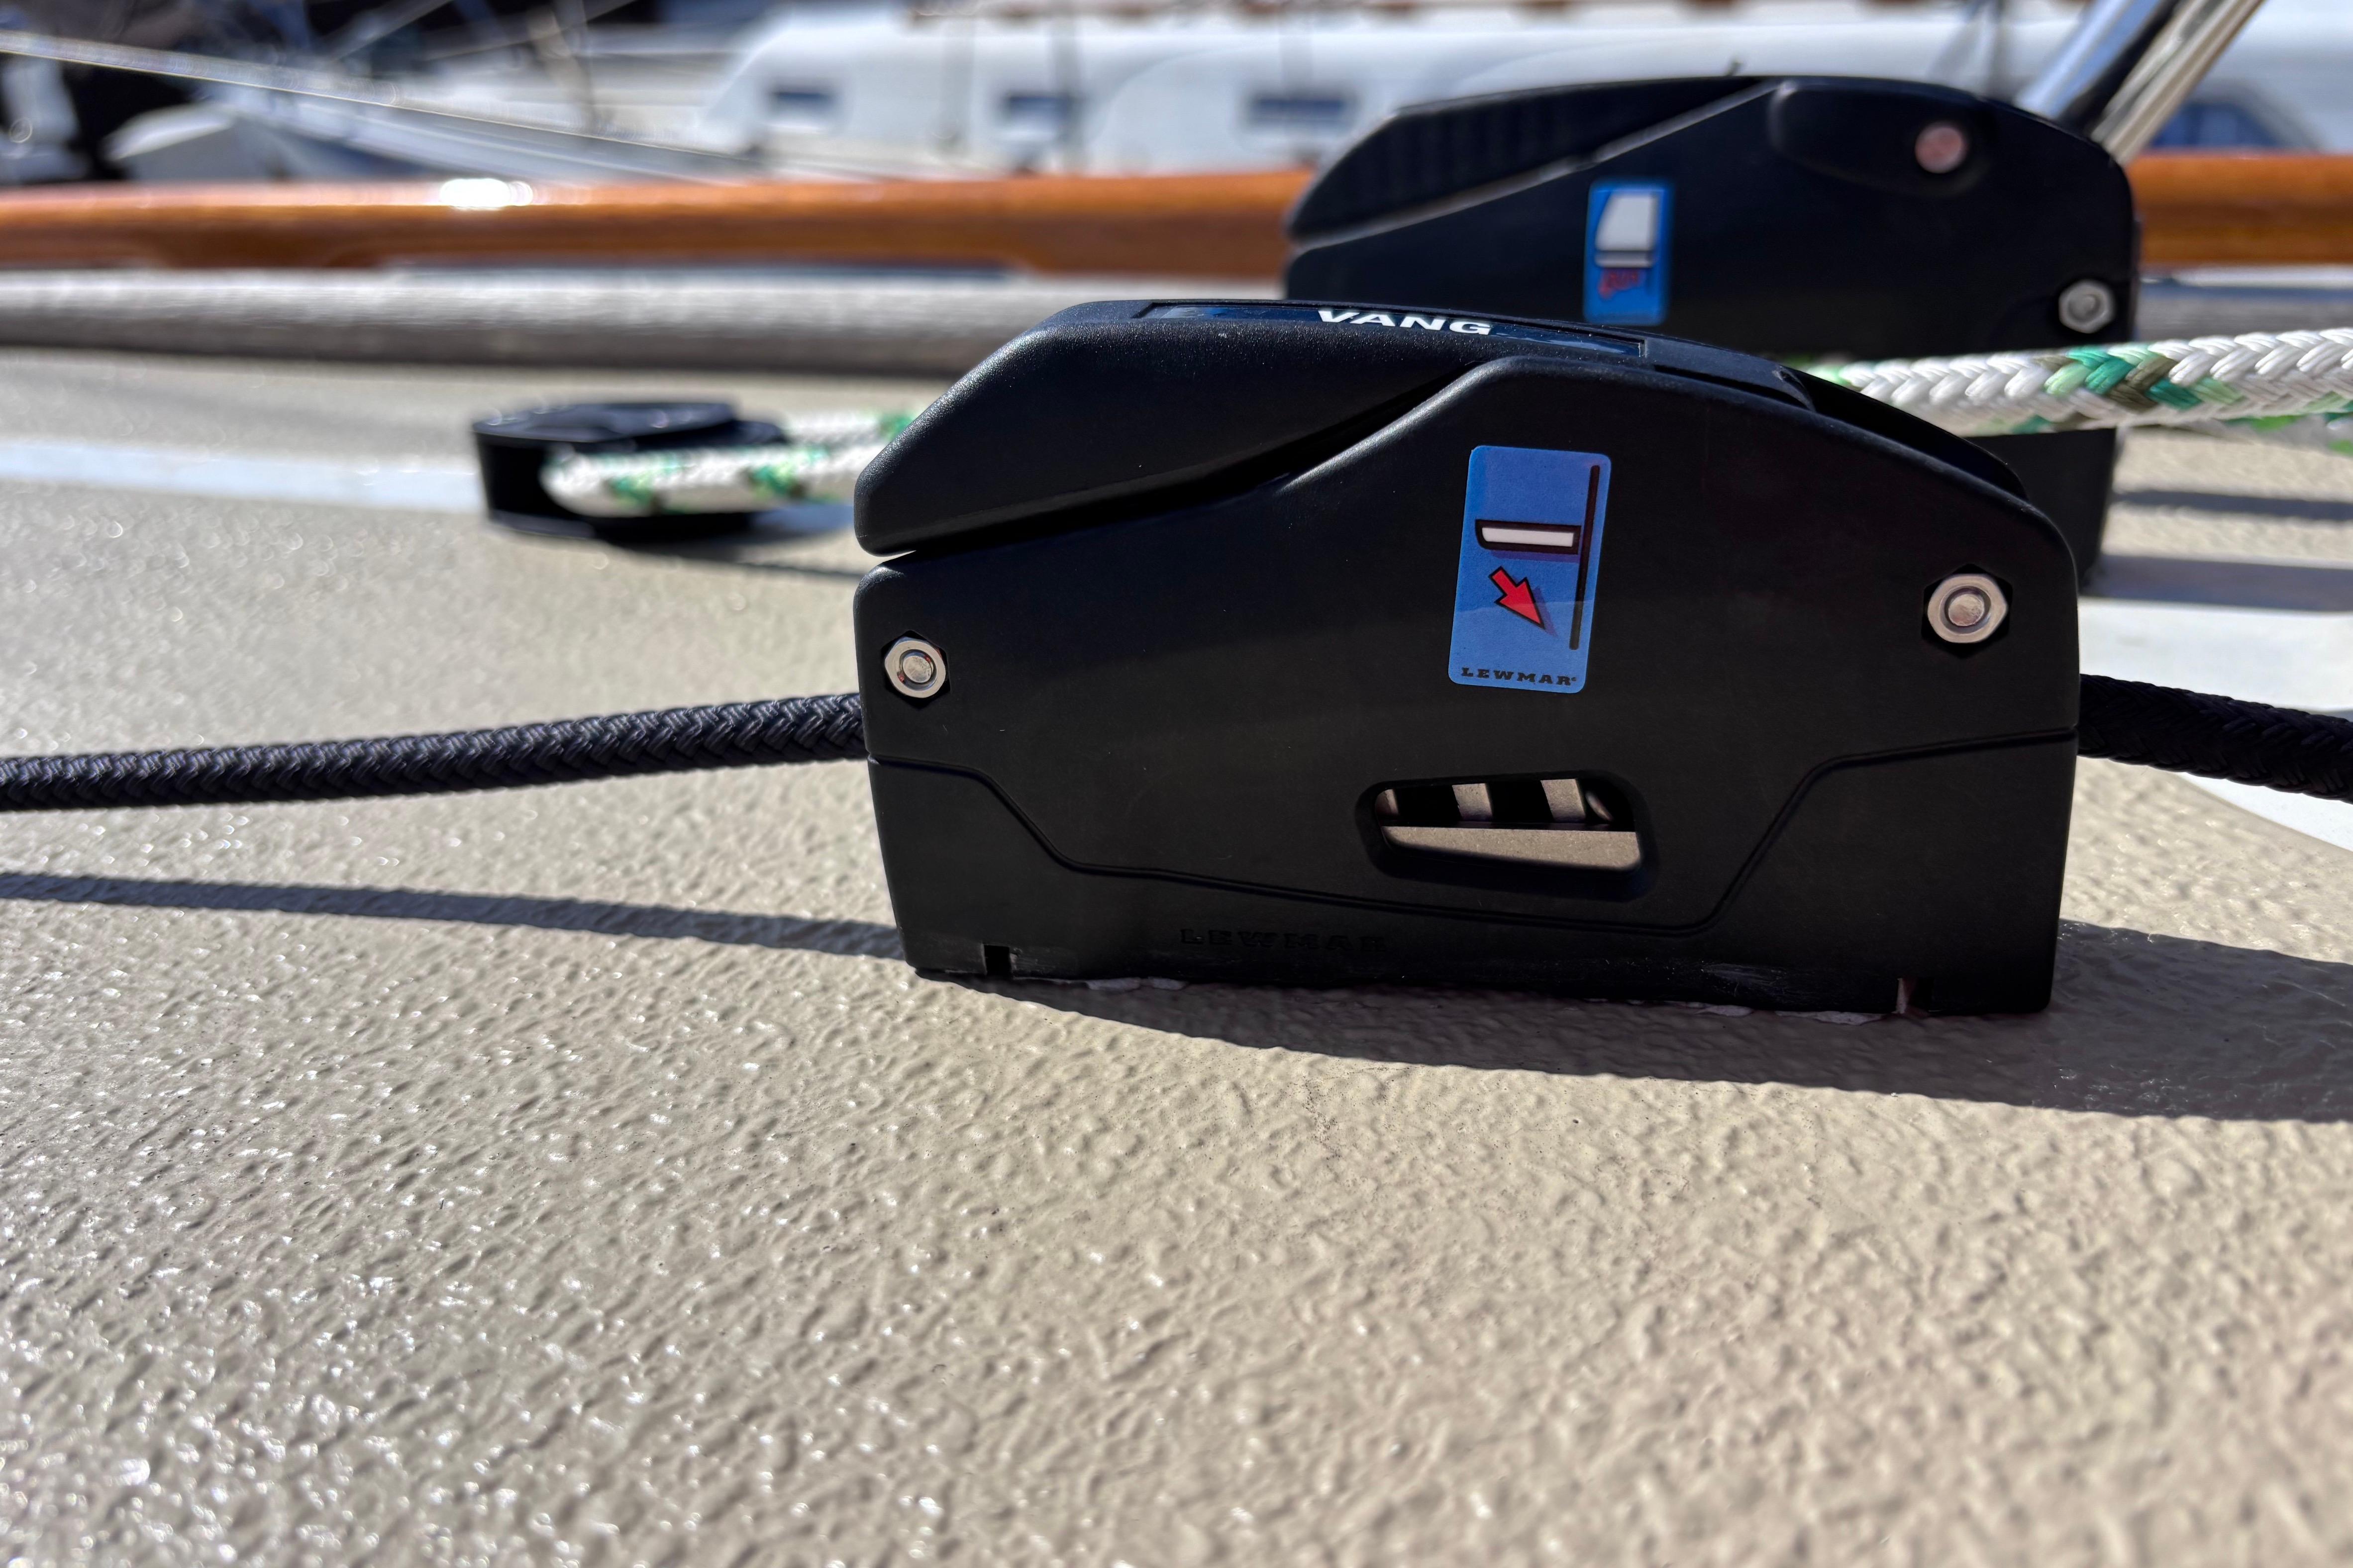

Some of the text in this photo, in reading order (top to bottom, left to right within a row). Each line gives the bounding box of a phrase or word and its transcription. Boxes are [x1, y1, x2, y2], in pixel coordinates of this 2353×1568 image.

[1318, 309, 1493, 335] VANG
[1461, 667, 1572, 686] LEWMAR
[1180, 929, 1386, 953] LEWMAR
